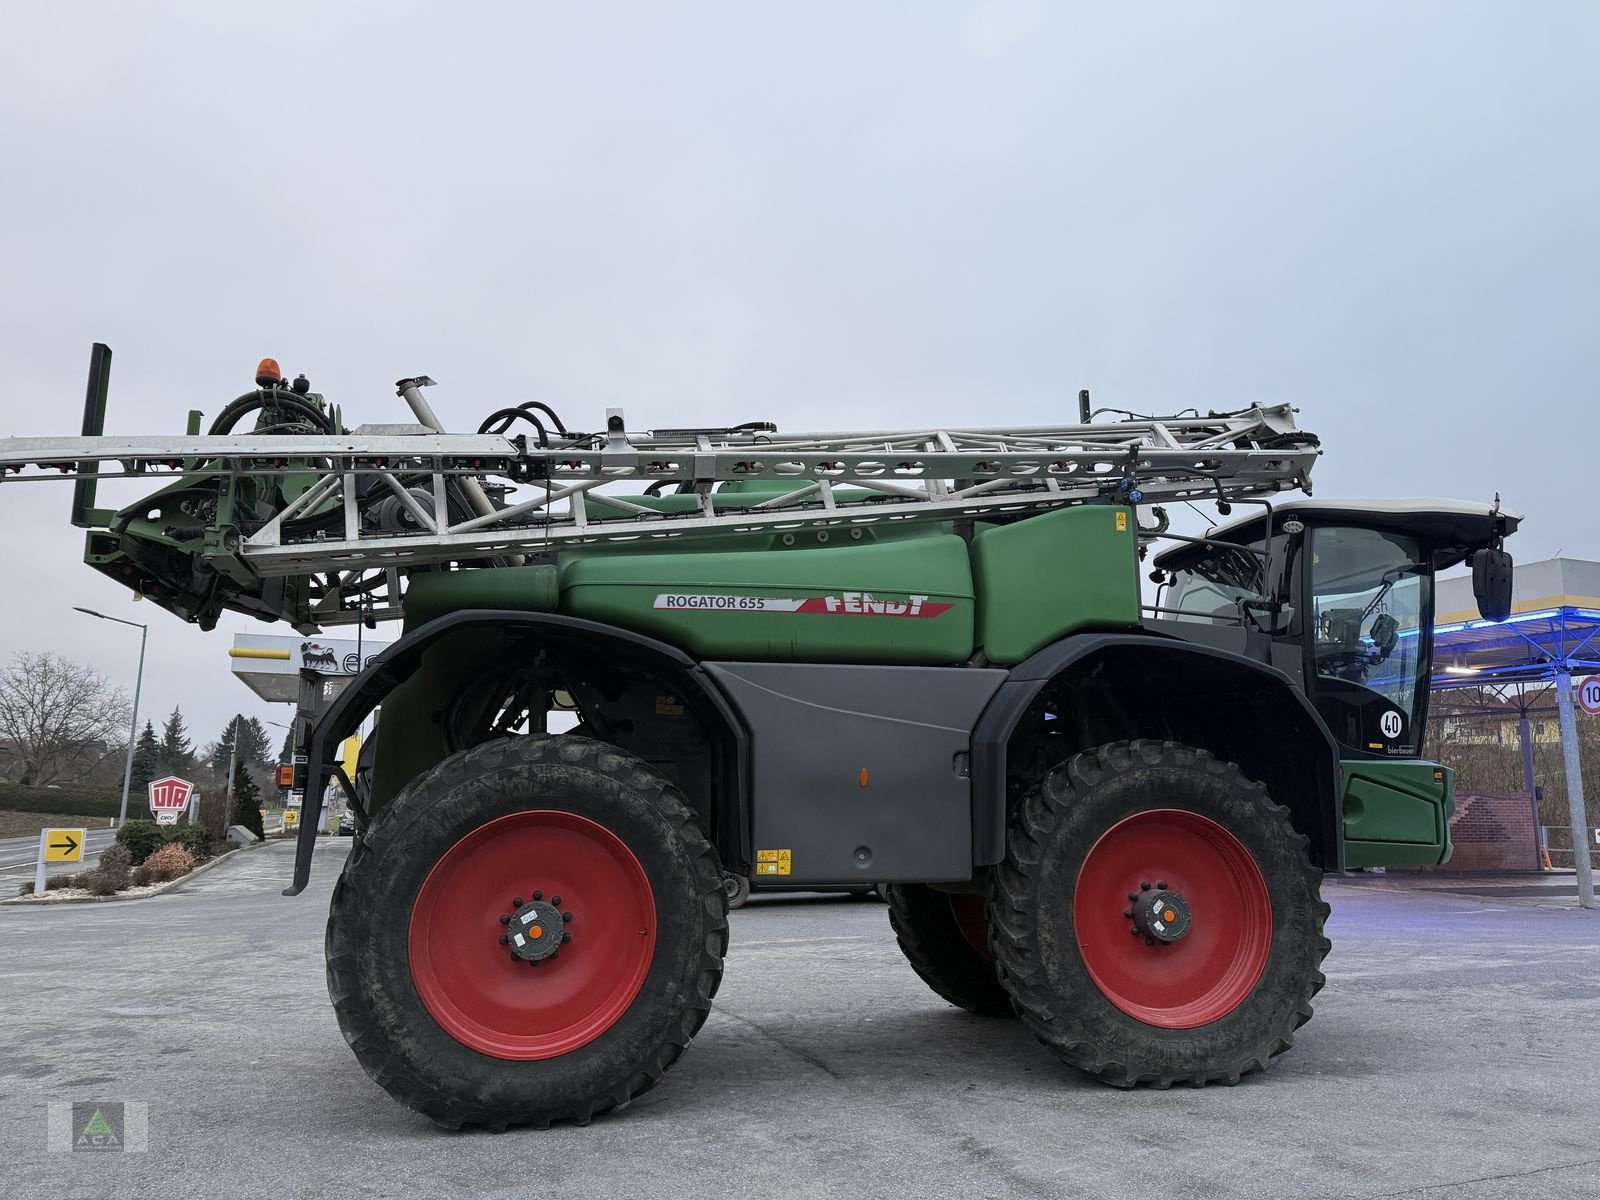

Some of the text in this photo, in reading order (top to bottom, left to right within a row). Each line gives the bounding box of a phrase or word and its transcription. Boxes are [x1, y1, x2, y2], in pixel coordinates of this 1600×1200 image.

[667, 592, 929, 615] ROGATOR 655 FENDT
[1585, 686, 1600, 704] 10
[1384, 715, 1399, 734] 40
[152, 779, 189, 808] UTA
